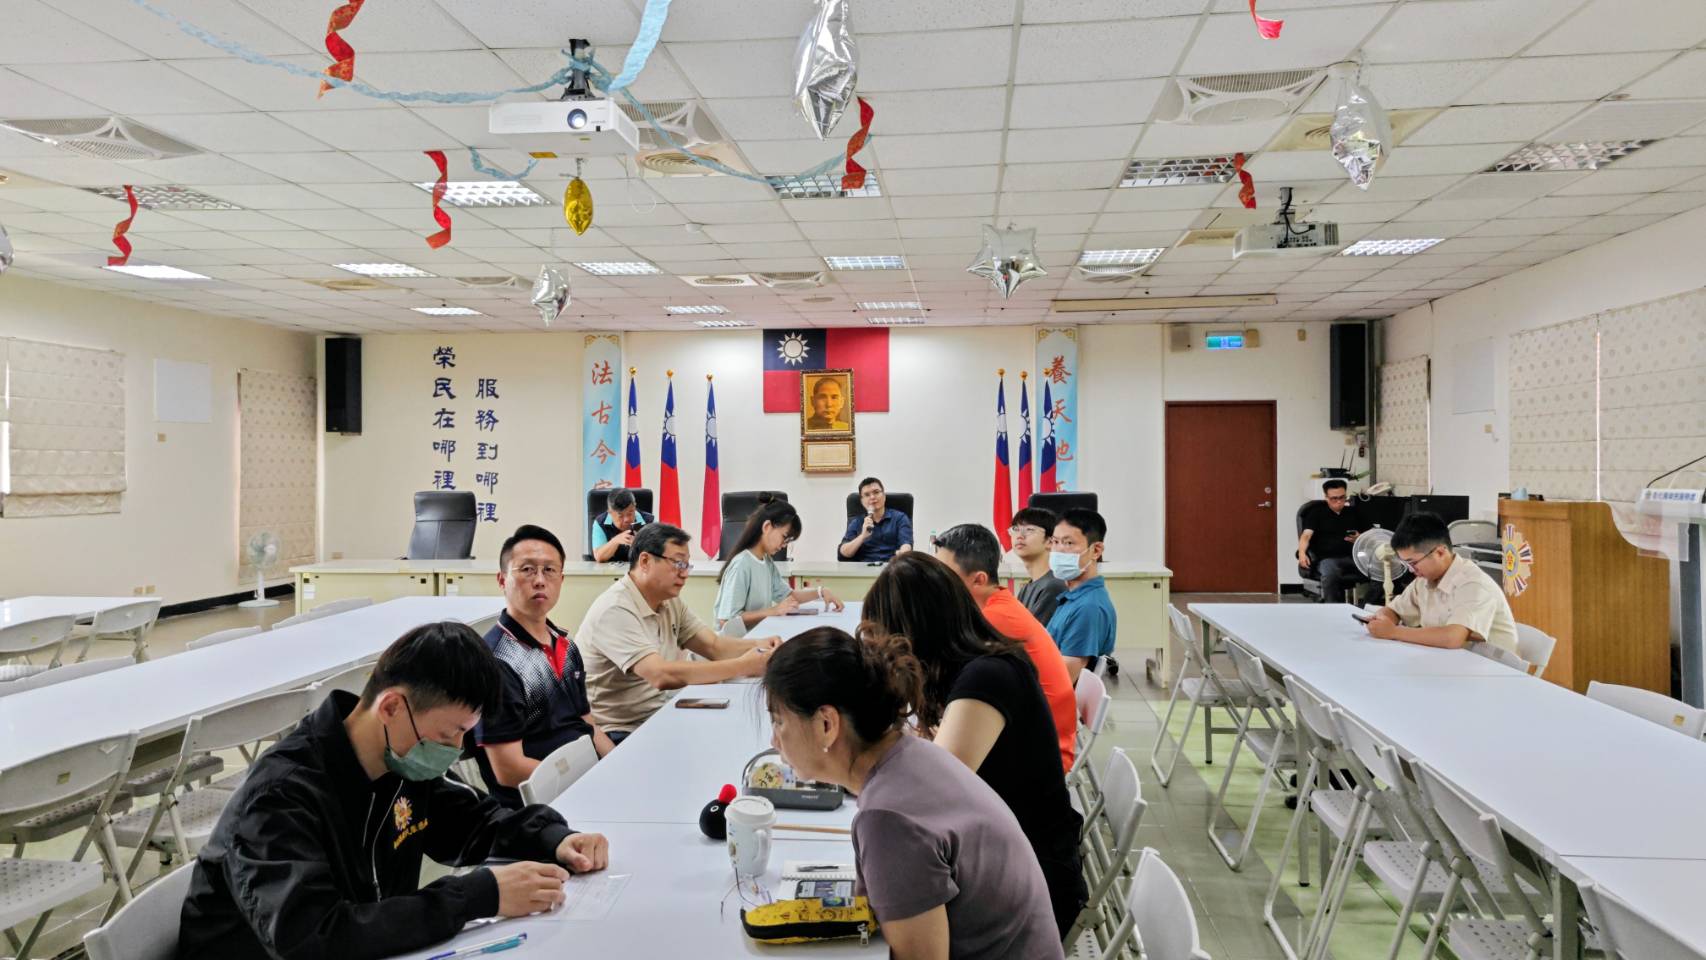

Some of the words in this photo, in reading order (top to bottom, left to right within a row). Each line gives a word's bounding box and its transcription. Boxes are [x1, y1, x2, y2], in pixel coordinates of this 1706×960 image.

[432, 346, 456, 490] 榮民在哪裡
[475, 378, 500, 523] 服務到哪裡
